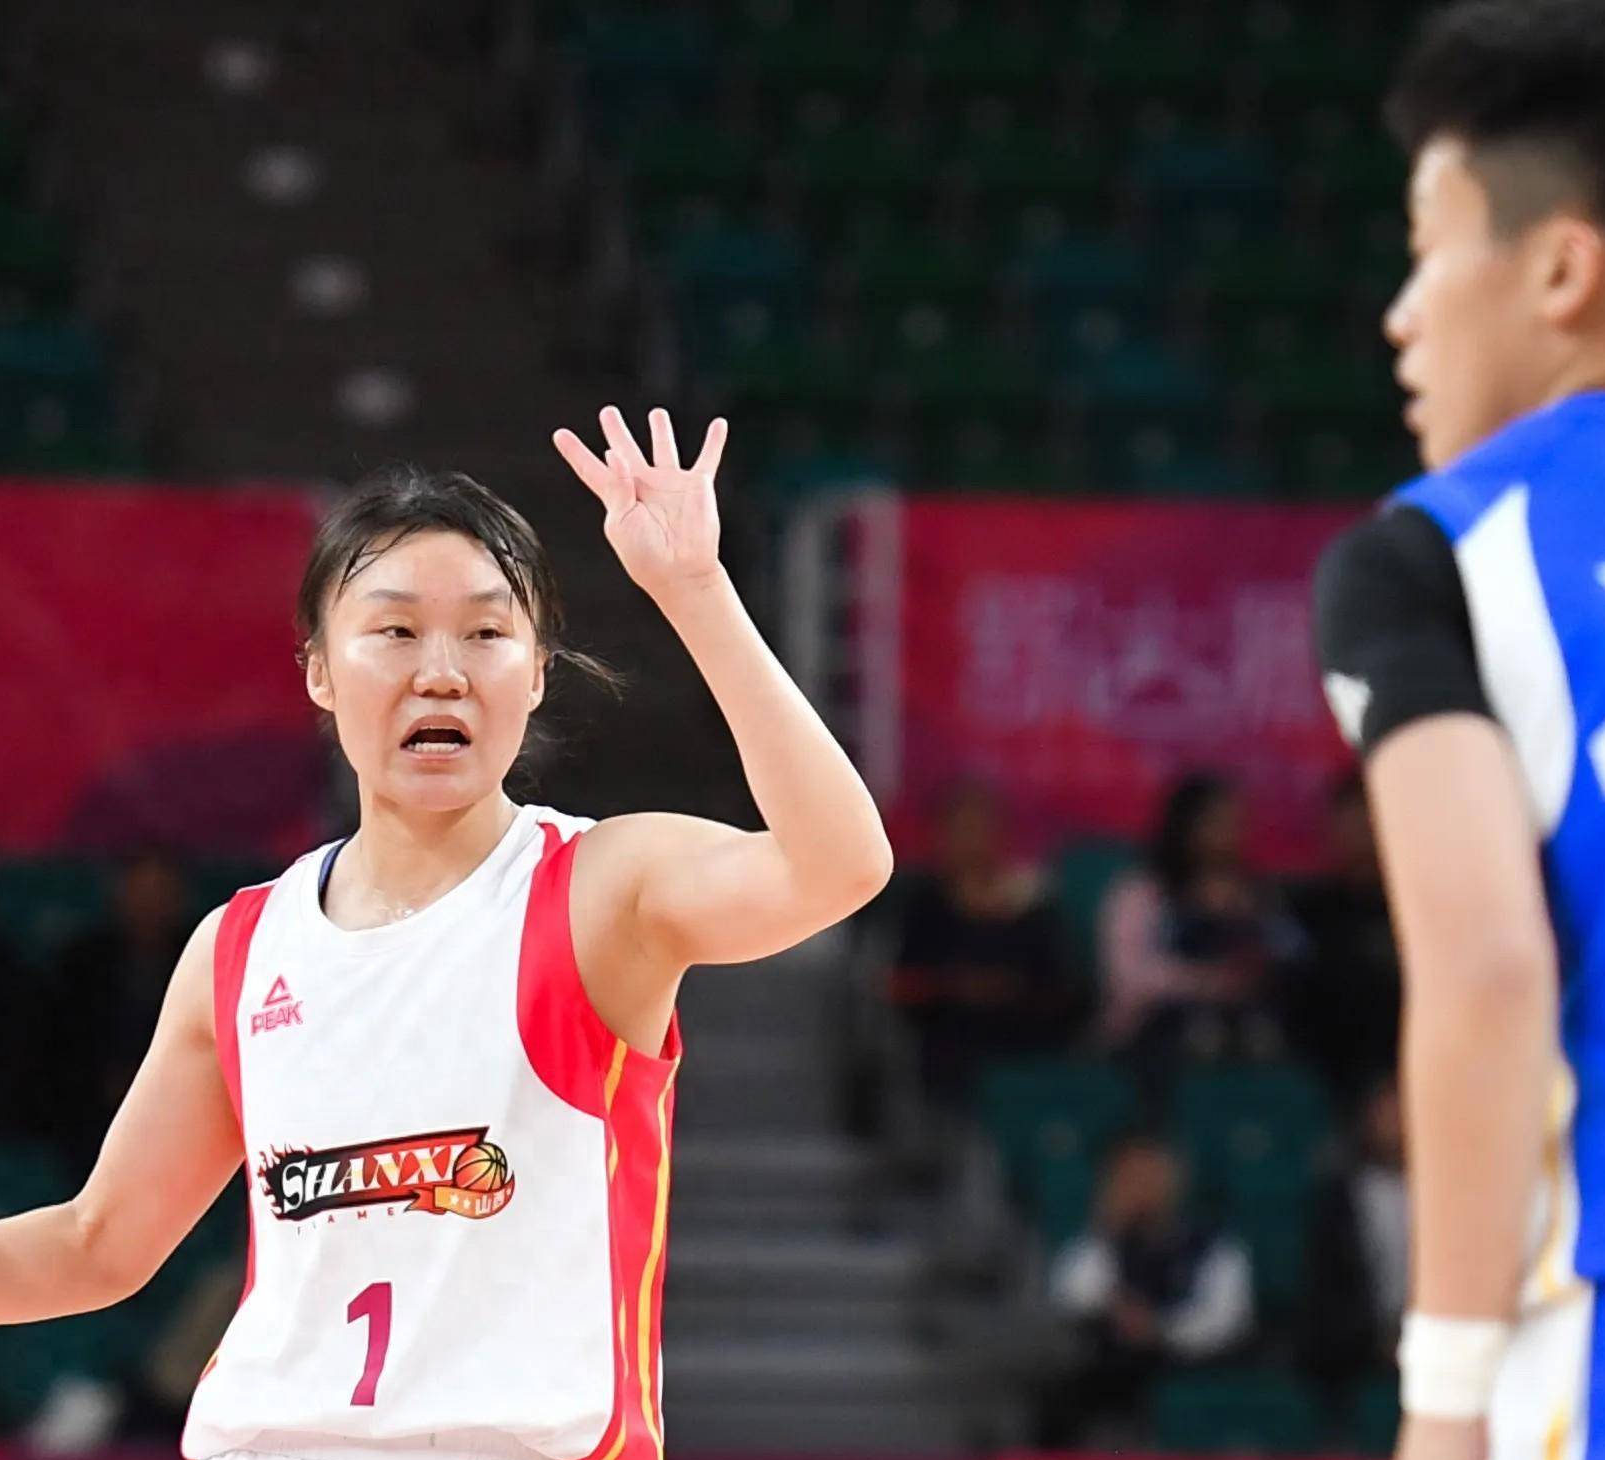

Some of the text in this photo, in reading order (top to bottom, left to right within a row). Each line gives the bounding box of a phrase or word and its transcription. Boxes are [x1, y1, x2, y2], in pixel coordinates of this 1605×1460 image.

[251, 1000, 303, 1036] PEAK
[281, 1142, 468, 1214] SHANXI
[347, 1281, 393, 1407] 1
